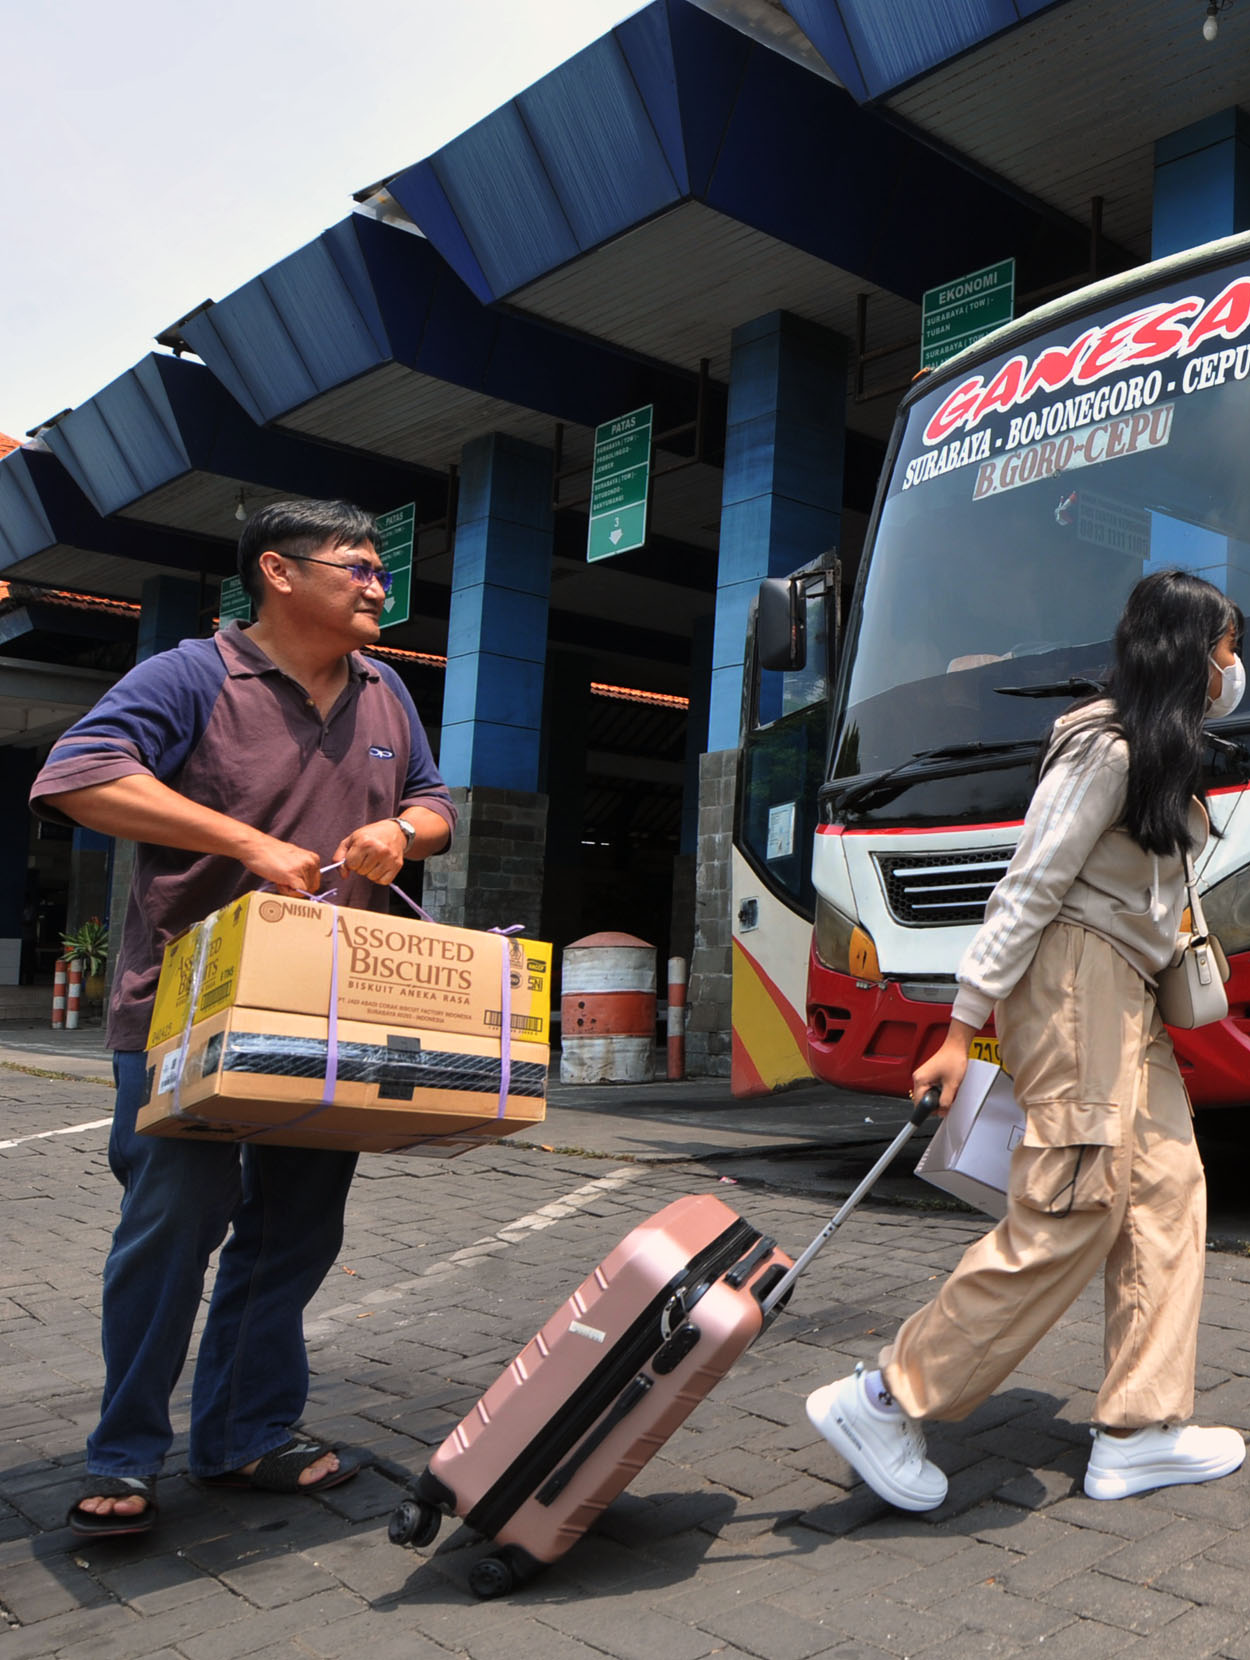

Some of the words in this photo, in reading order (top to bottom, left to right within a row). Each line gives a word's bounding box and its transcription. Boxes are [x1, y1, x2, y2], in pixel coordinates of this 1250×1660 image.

[939, 271, 998, 305] EKONOMI
[926, 308, 964, 327] SURABAYA
[926, 323, 951, 338] TUBAN
[925, 342, 962, 360] SURABAYA
[611, 416, 637, 435] PATAS
[902, 428, 991, 491] SURABAYA
[1005, 370, 1162, 452] BOJONEGORO
[614, 517, 620, 528] 3
[282, 902, 322, 920] NISSIN
[326, 915, 474, 963] ASSORTED
[350, 946, 472, 990] BISCUITS
[348, 980, 394, 994] BISKUIT
[400, 987, 437, 1000] ANEKA
[443, 994, 471, 1005] RASA
